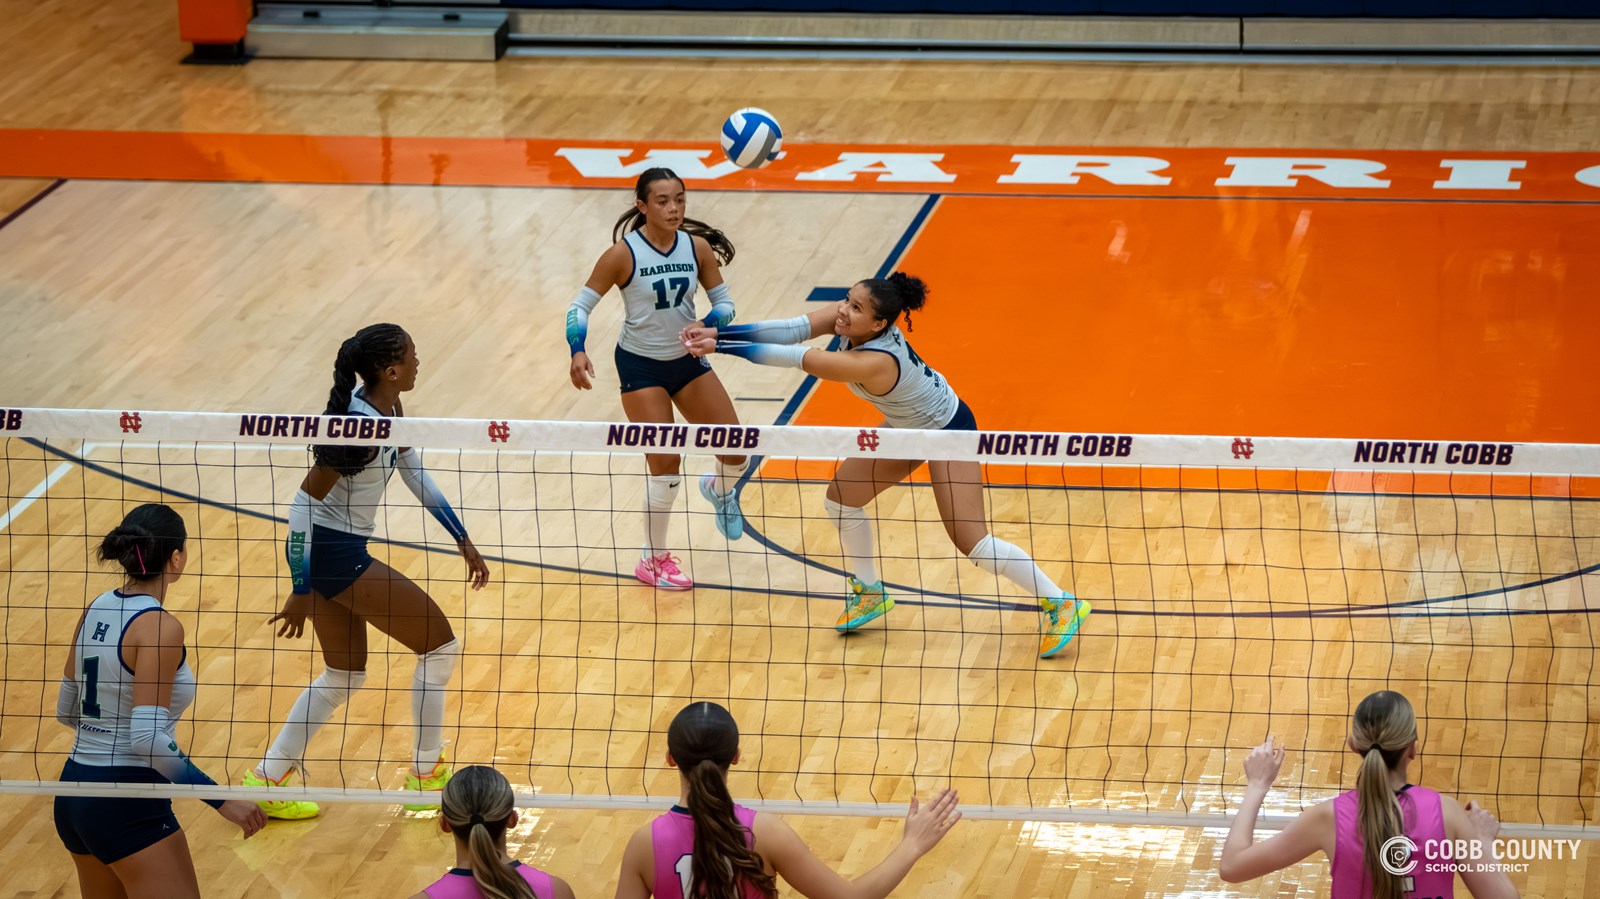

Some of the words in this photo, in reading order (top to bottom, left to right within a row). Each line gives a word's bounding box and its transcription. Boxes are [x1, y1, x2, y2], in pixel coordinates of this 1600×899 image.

[554, 147, 1600, 190] WARRI
[639, 263, 695, 277] HARRISON
[652, 276, 690, 310] 17
[239, 414, 320, 438] NORTH
[326, 417, 392, 440] COBB
[606, 424, 688, 447] NORTH
[695, 426, 760, 449] COBB
[977, 433, 1060, 456] NORTH
[1066, 435, 1133, 458] COBB
[1354, 441, 1438, 464] NORTH
[1445, 443, 1514, 466] COBB
[91, 621, 111, 643] H
[81, 655, 101, 720] 1
